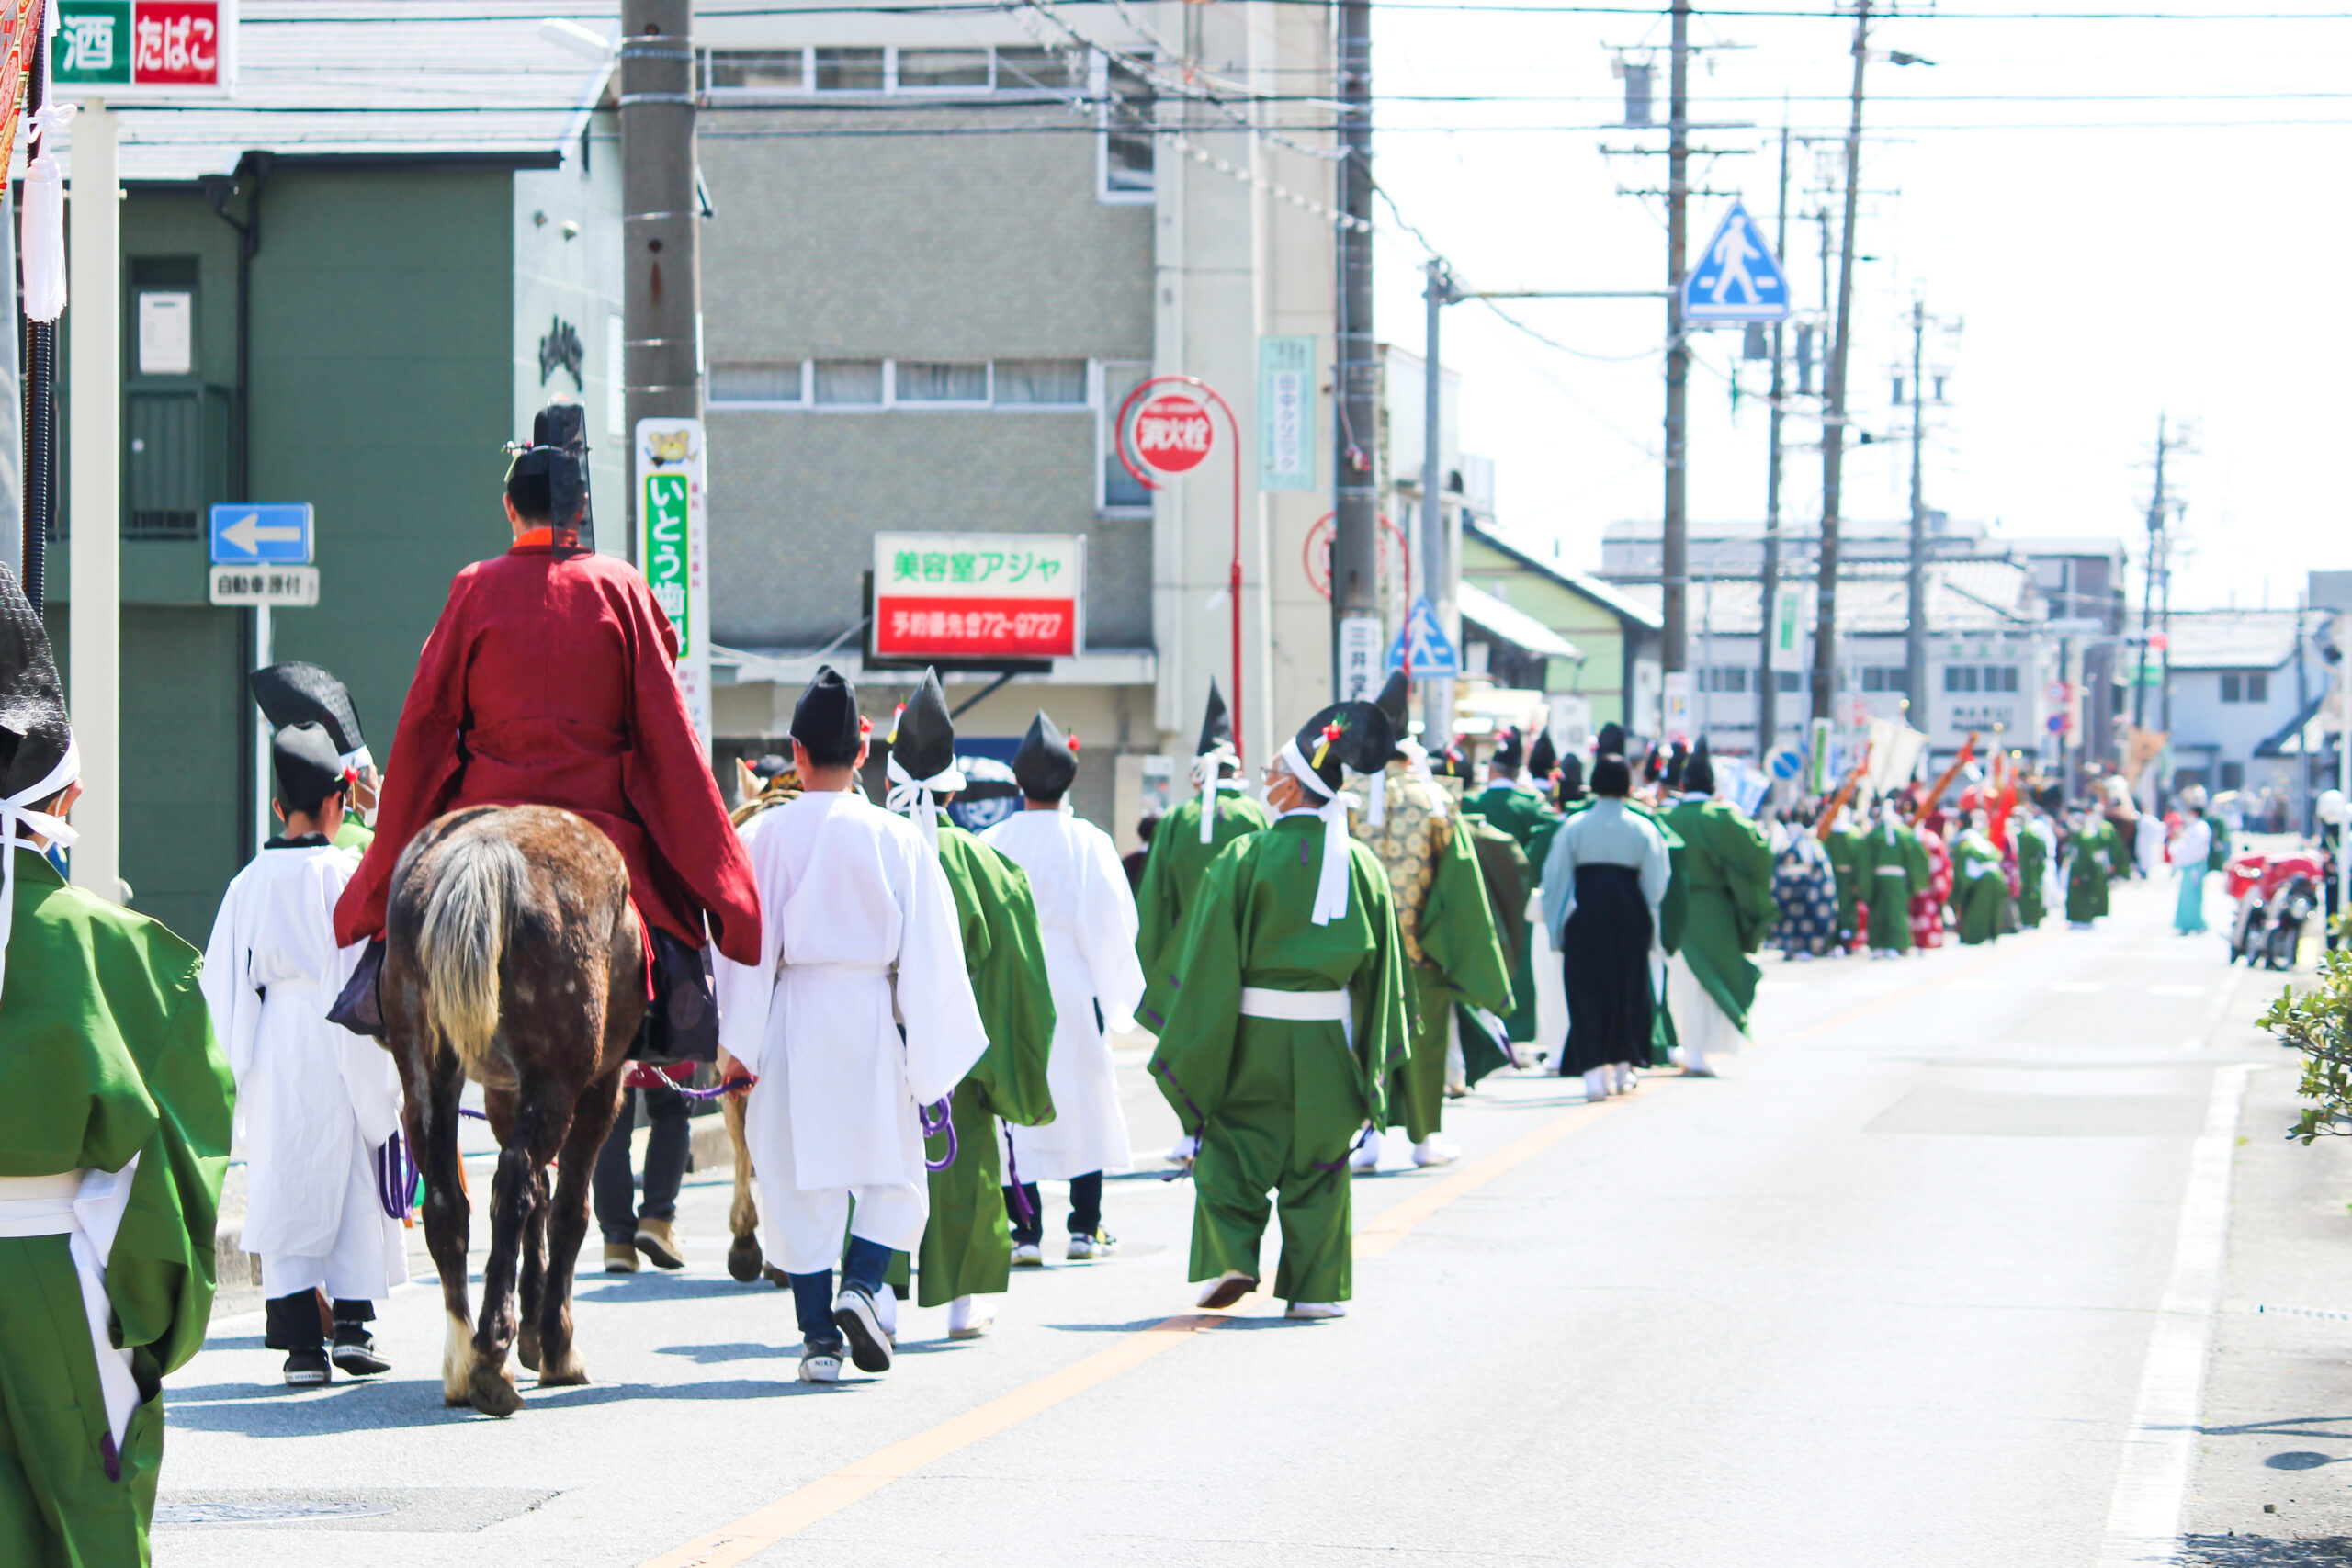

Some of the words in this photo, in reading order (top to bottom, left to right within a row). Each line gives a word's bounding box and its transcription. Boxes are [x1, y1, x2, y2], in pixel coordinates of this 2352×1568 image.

[63, 15, 116, 71] 酒
[137, 15, 216, 71] たばこ
[1140, 416, 1209, 451] 消火栓
[650, 477, 686, 656] いとう歯
[892, 550, 1061, 582] 美容室アジャ
